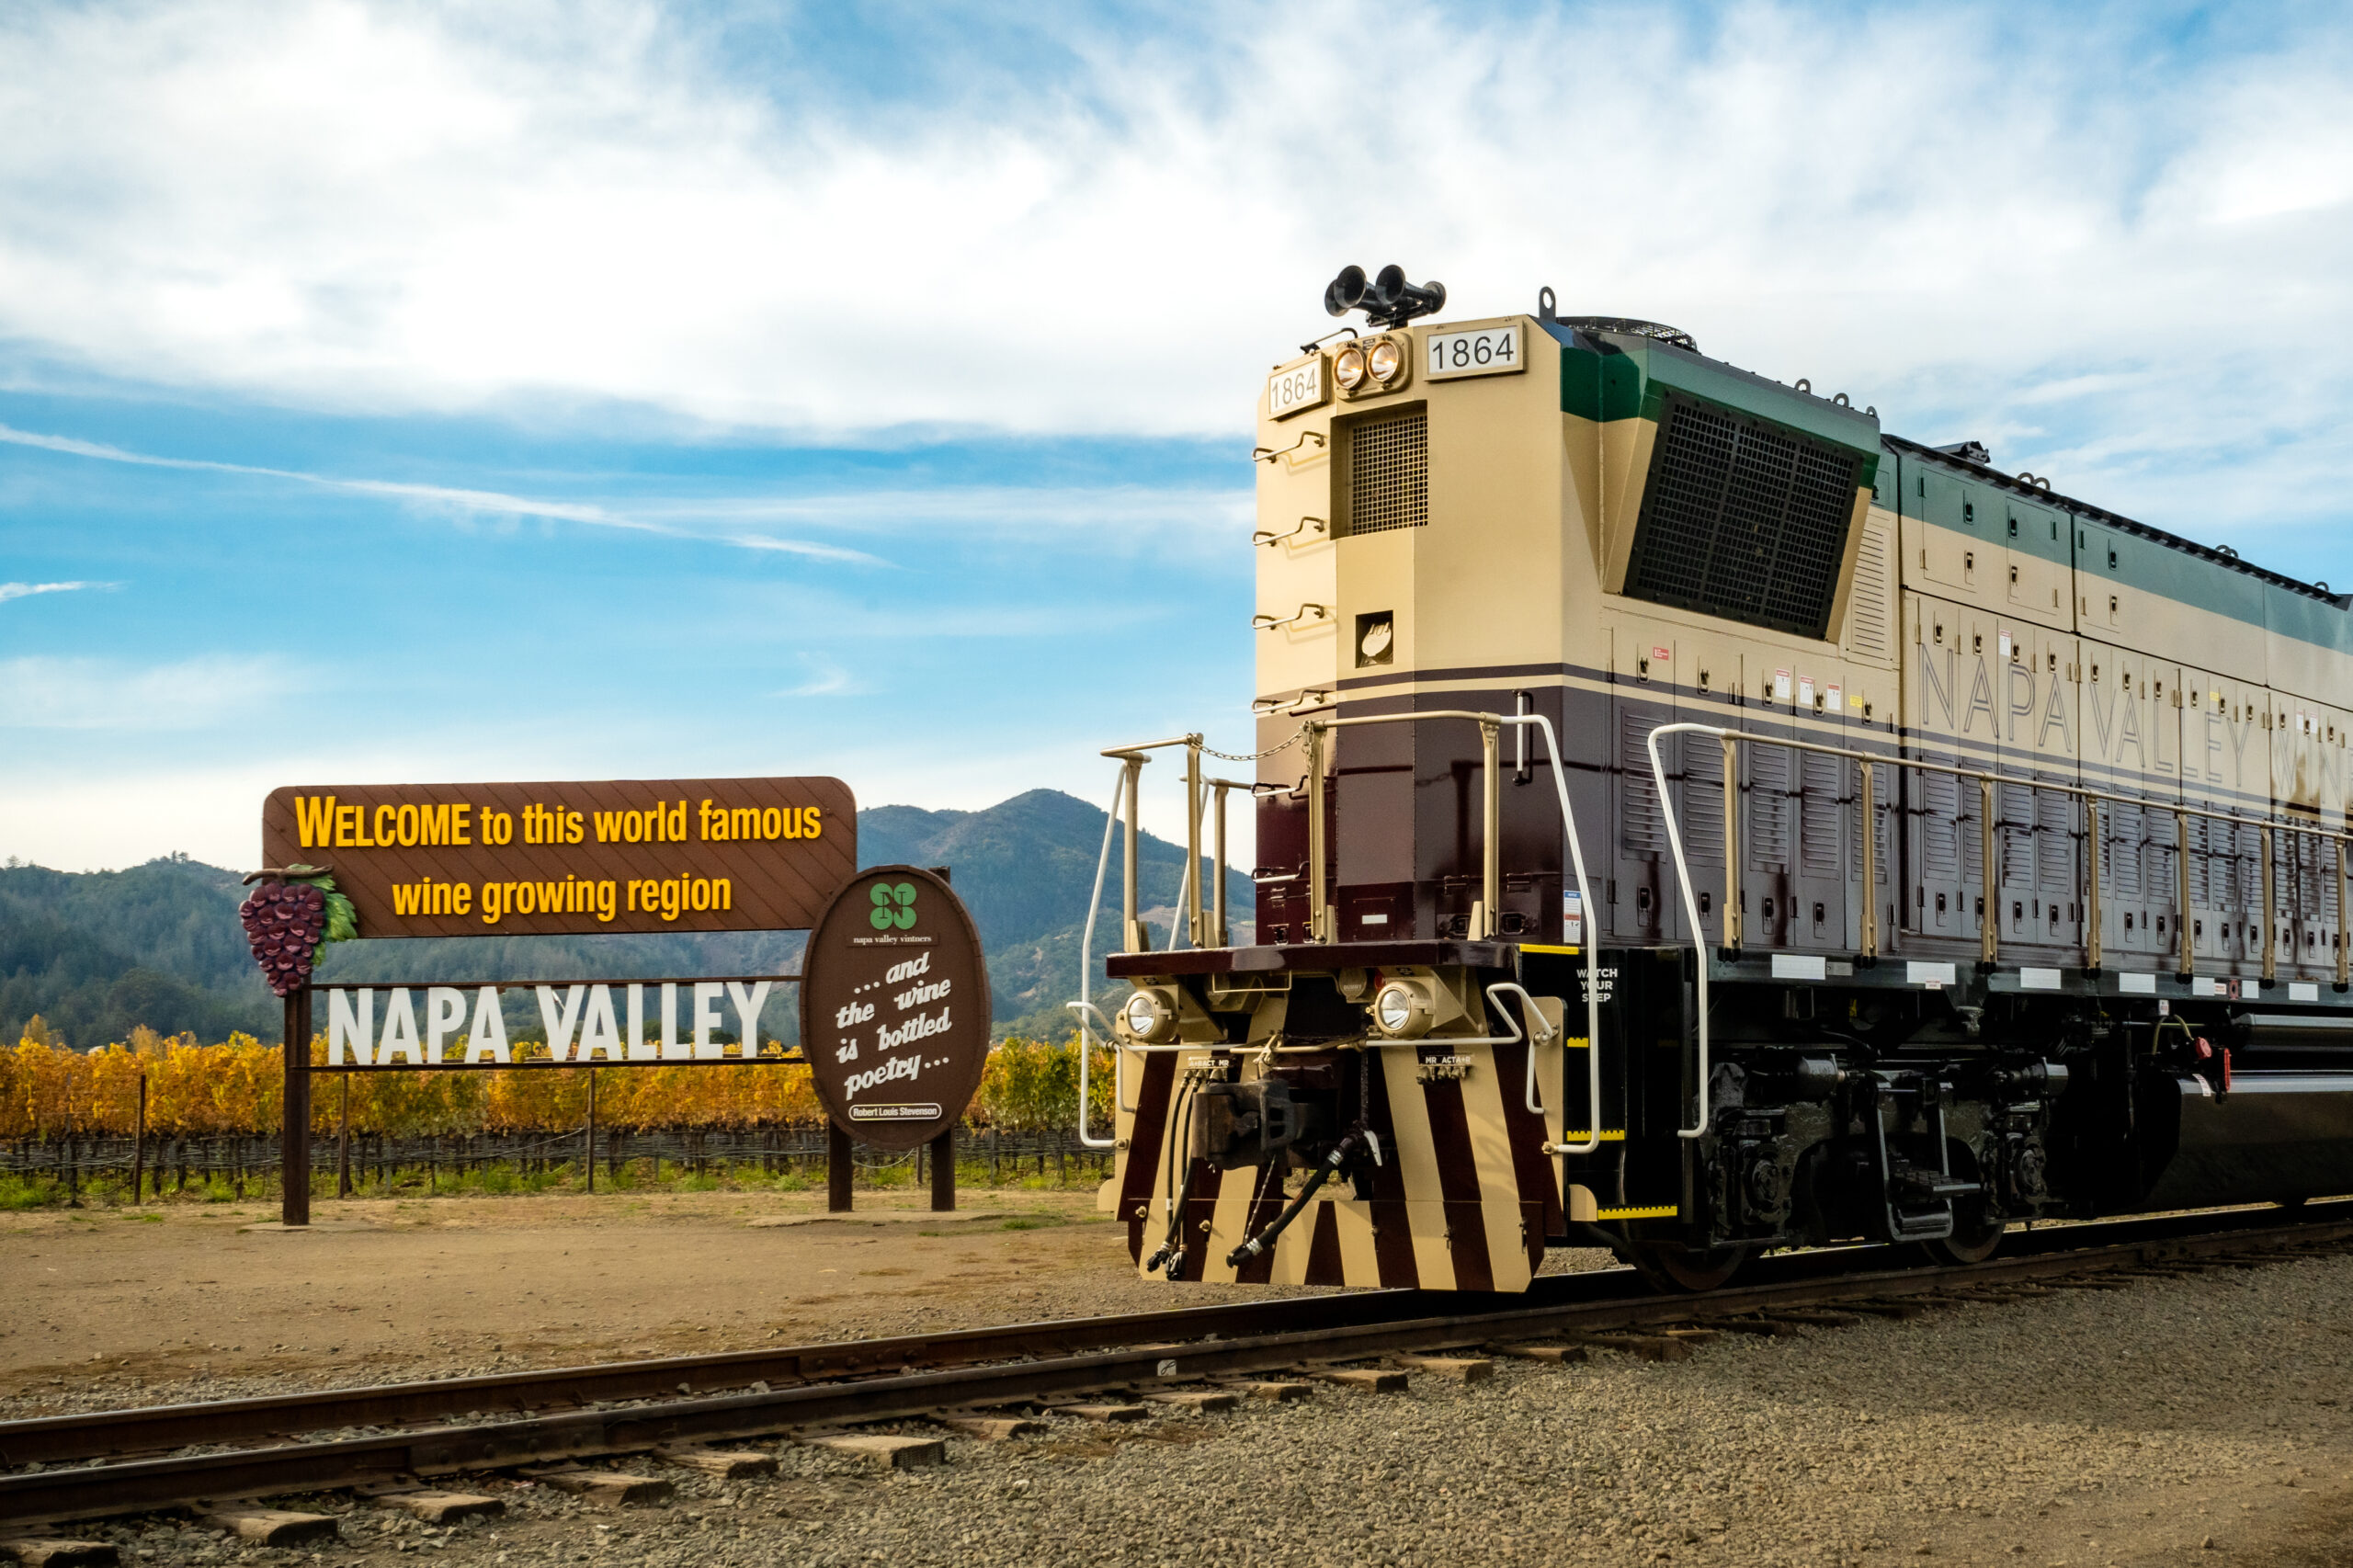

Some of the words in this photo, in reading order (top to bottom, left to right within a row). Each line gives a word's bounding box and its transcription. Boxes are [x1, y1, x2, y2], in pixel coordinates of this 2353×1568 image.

[1432, 334, 1514, 369] 1864
[1271, 368, 1317, 409] 1864
[1921, 643, 2072, 753] NAPA
[2088, 681, 2251, 788] VALLEY
[295, 796, 472, 847] WELCOME
[481, 805, 513, 846] to
[522, 803, 584, 845] this
[594, 800, 688, 843] world
[699, 799, 822, 840] famous
[392, 876, 472, 915] wine
[482, 874, 618, 924] growing
[627, 872, 732, 922] region
[853, 936, 873, 945] napa
[875, 934, 898, 945] valley
[900, 935, 932, 943] vintners
[835, 1001, 875, 1029] the
[893, 979, 951, 1011] wine
[1580, 981, 1613, 991] YUR
[1582, 993, 1611, 1003] SEP
[327, 987, 512, 1065] NAPA
[535, 981, 772, 1062] VALLEY
[835, 1037, 858, 1063] is
[876, 1006, 952, 1051] bottled
[1425, 1056, 1437, 1064] MR
[853, 1107, 878, 1117] Robert
[879, 1106, 898, 1116] Louis
[899, 1106, 938, 1117] Stevenson
